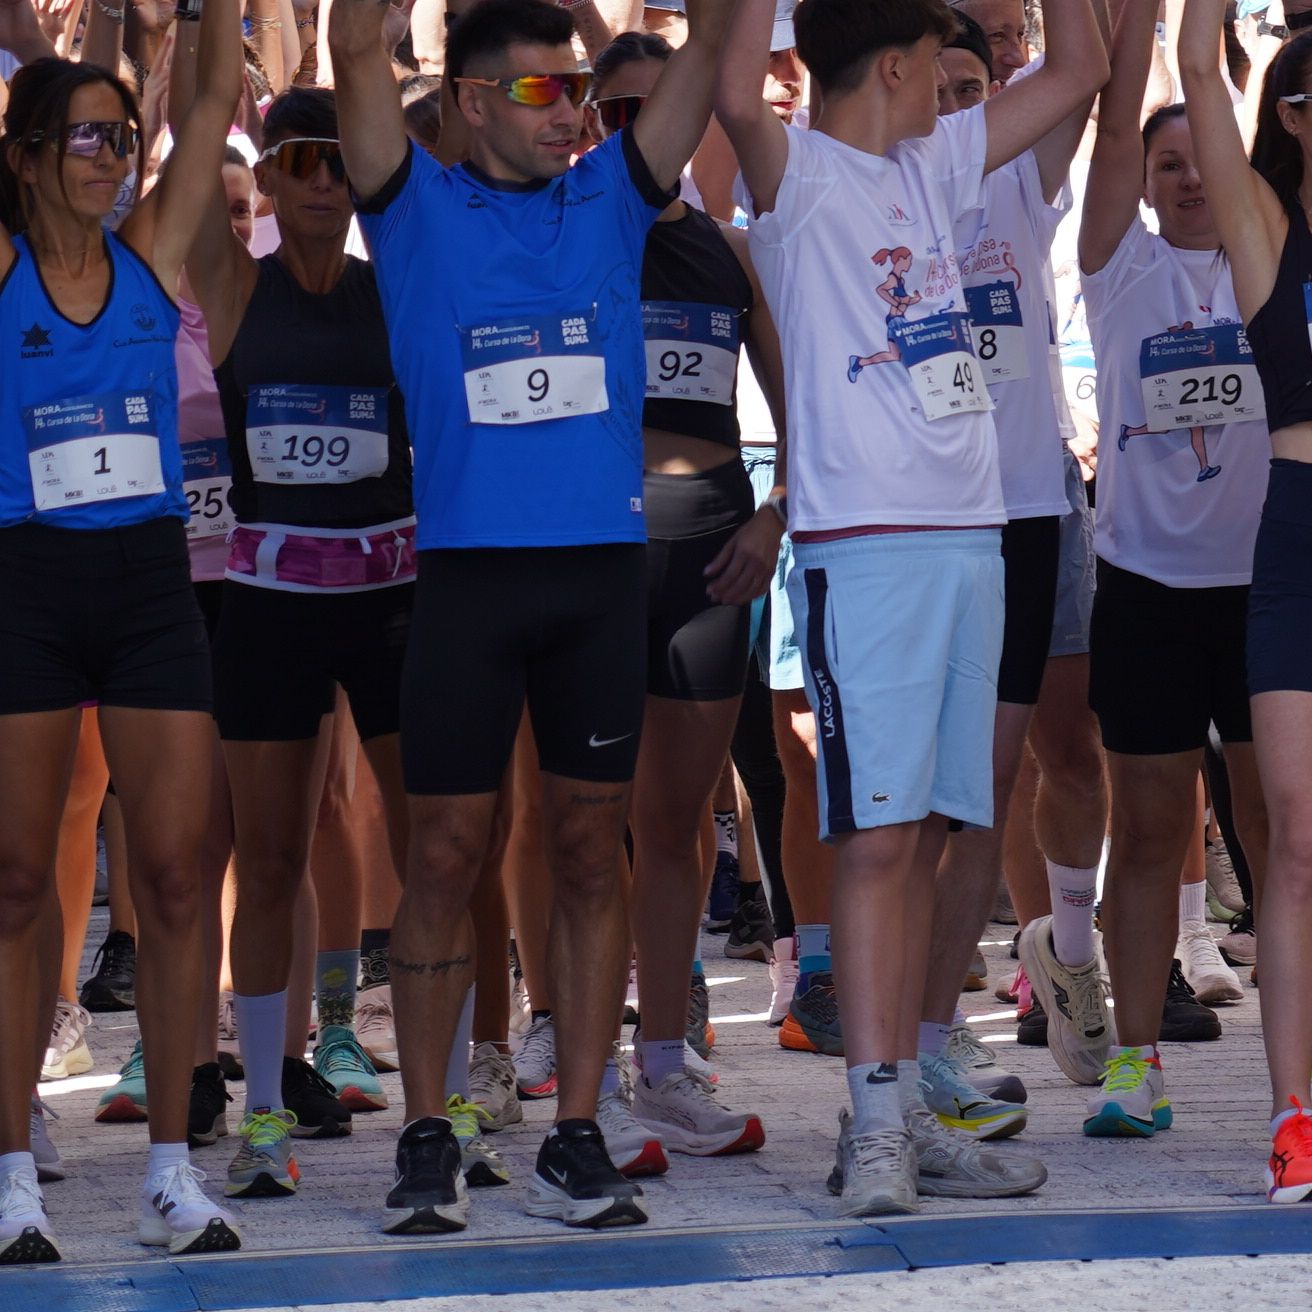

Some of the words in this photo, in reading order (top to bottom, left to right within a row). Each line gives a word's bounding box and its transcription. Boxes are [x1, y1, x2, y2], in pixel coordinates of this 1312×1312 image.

[989, 290, 1009, 298] CADA
[990, 297, 1011, 306] PAS
[992, 305, 1012, 315] SUMA
[561, 318, 586, 326] CADA
[471, 326, 499, 337] MORA
[562, 326, 588, 336] PAS
[564, 335, 589, 346] SUMA
[658, 351, 703, 382] 92
[953, 362, 974, 393] 49
[527, 368, 550, 402] 9
[1179, 373, 1242, 406] 219
[125, 396, 146, 405] CADA
[350, 394, 375, 402] CADA
[34, 404, 61, 417] MORA
[126, 404, 148, 414] PAS
[350, 402, 375, 411] PAS
[128, 414, 150, 424] SUMA
[350, 410, 375, 419] SUMA
[281, 435, 350, 467] 199
[94, 447, 111, 475] 1
[814, 668, 836, 738] LACOSTE
